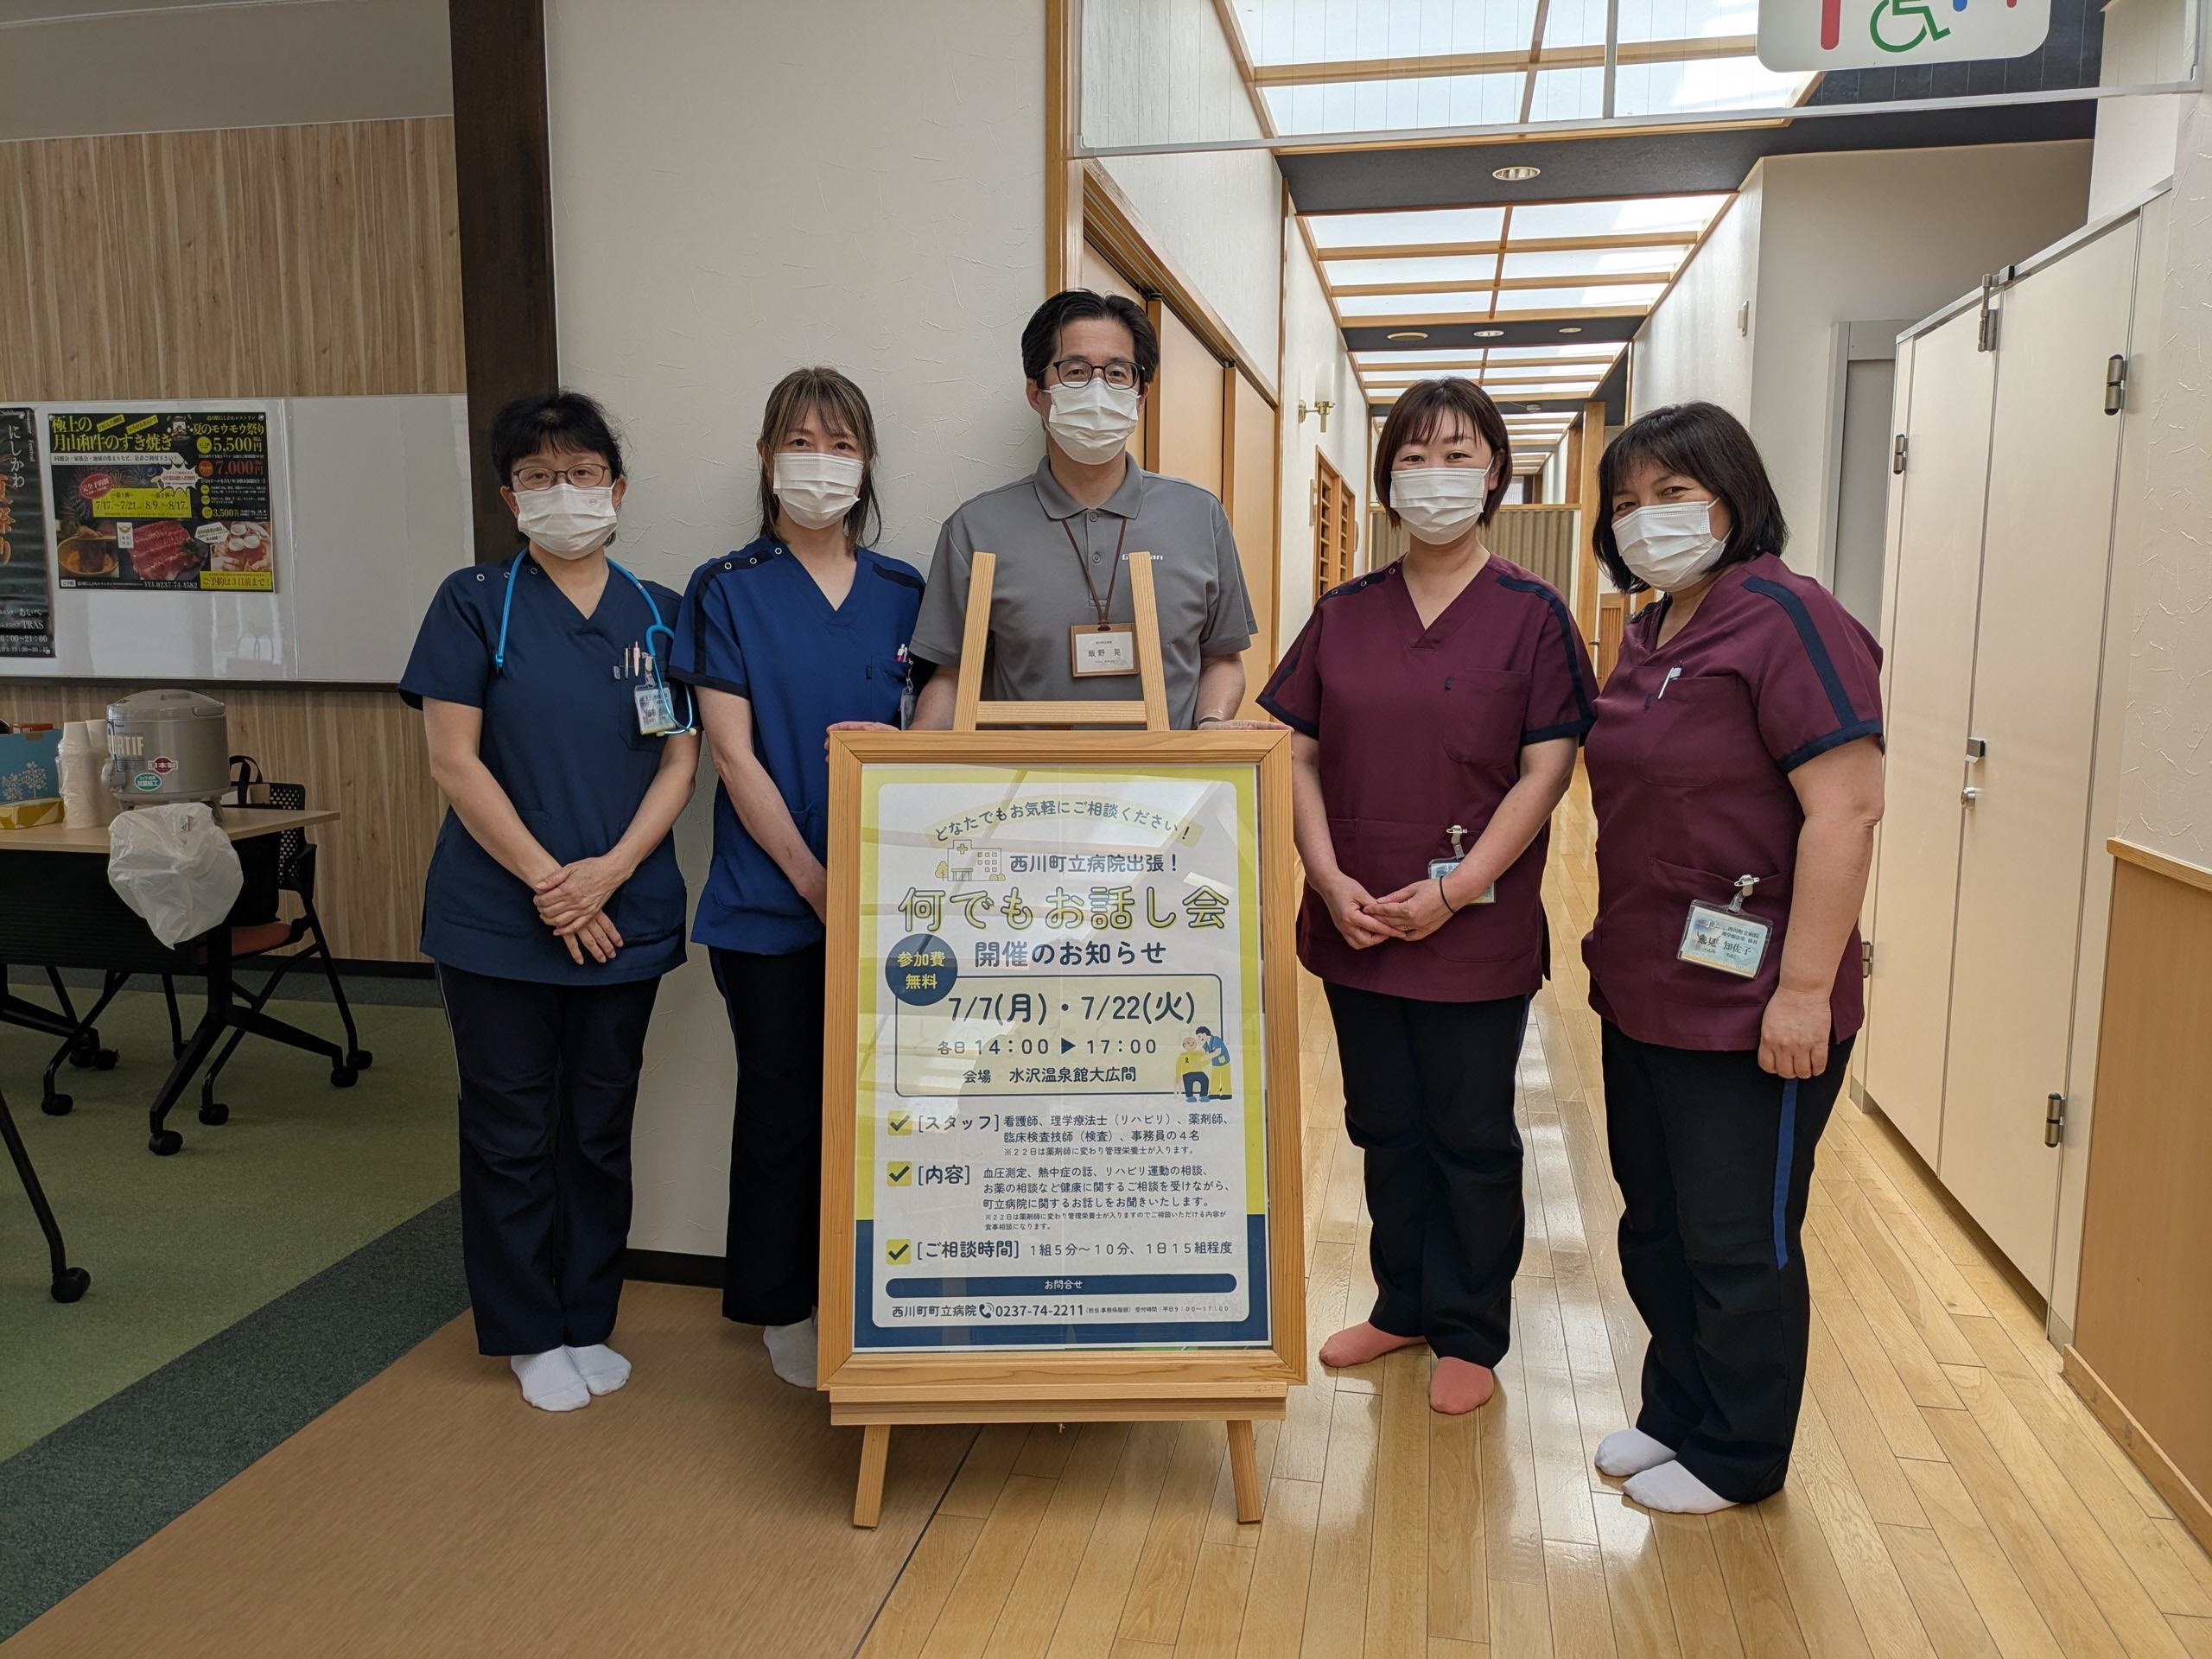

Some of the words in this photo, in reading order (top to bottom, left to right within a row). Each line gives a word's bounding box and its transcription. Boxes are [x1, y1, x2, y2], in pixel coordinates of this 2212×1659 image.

[52, 415, 92, 432] 極上の
[193, 423, 264, 435] 夏のモウモウ祭り
[54, 434, 172, 451] 月山和牛のすき焼き
[9, 424, 25, 488] にしかわ
[22, 620, 44, 630] TRAS
[934, 800, 1191, 842] どなたでもお気軽にご相談ください!
[1009, 854, 1178, 874] 西川町立病院出張!
[897, 885, 1230, 933] 何でもお話し会
[897, 951, 945, 968] 参加費
[975, 941, 1167, 967] 開催のお知らせ
[905, 973, 938, 990] 無料
[937, 1040, 965, 1055] 各日
[975, 1039, 1049, 1055] 14:00
[1086, 1039, 1157, 1054] 17:00
[963, 1070, 992, 1084] 会場
[1008, 1066, 1137, 1084] 水沢温泉館大広間
[918, 1113, 1000, 1134] [スタッフ]
[1003, 1128, 1201, 1144] 臨床検査技師(検査)、事務員の4名
[918, 1164, 971, 1186] [内容]
[982, 1165, 1209, 1179] 血圧測定、熱中症の話、リハビリ運動の相談、
[982, 1179, 1230, 1195] お薬の相談など健康に関するご相談を受けながら、
[982, 1196, 1211, 1210] 町立病院に関するお話しをお聞きいたします。
[985, 1223, 1052, 1231] 食事相談になります。
[918, 1239, 1020, 1260] [ご相談時間]
[1044, 1279, 1084, 1290] お問合せ
[892, 1304, 978, 1318] 西川町町立病院
[995, 1302, 1084, 1318] 0237-74-2211
